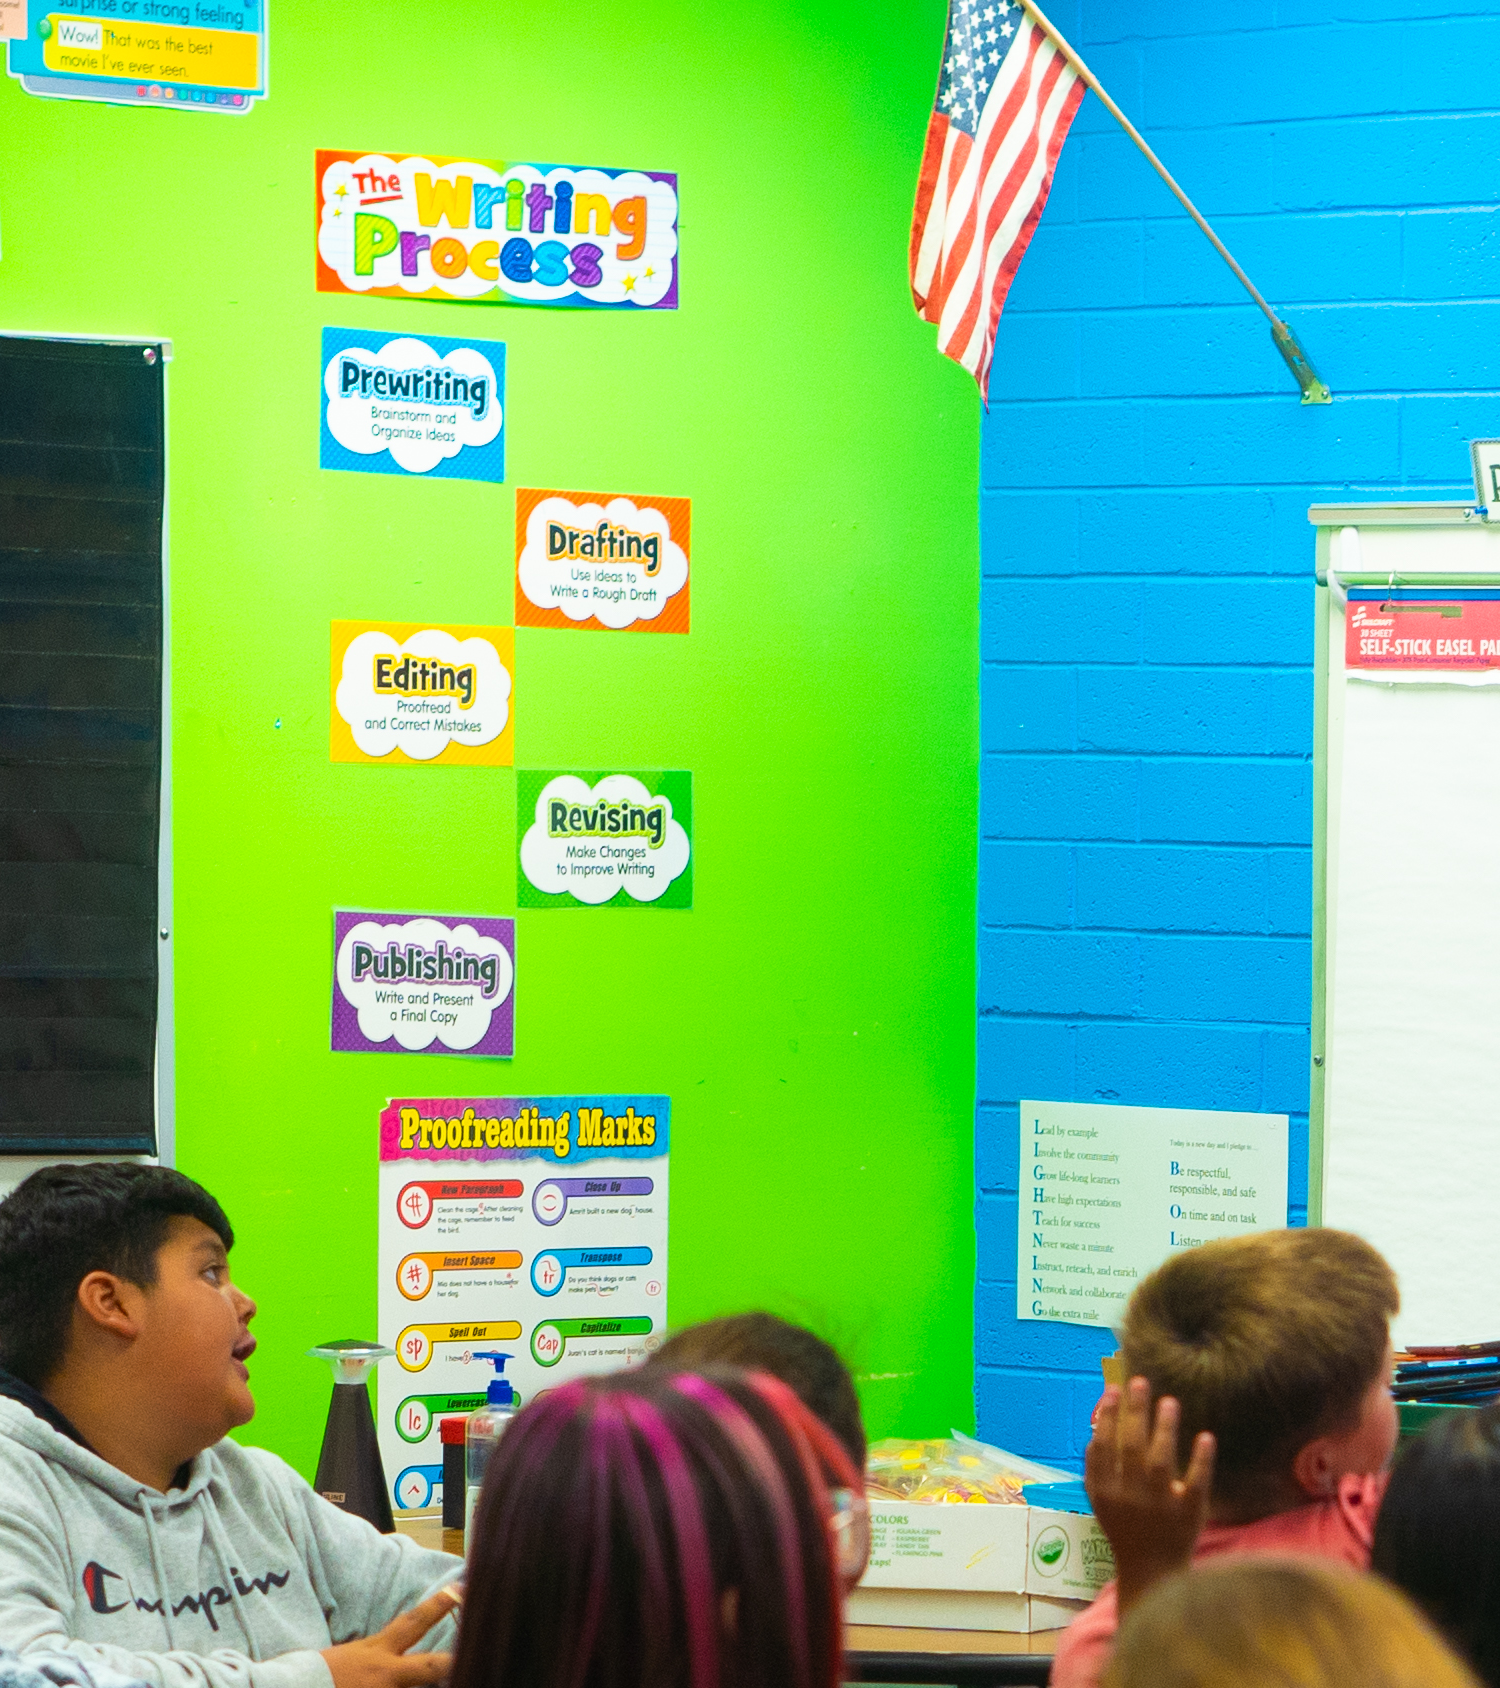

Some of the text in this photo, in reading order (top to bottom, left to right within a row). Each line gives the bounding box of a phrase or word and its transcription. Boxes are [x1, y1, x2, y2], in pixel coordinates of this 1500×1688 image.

[60, 25, 213, 55] Wow! That was the best
[353, 168, 647, 260] The Writing
[354, 212, 604, 287] Process
[341, 358, 488, 418] Prewriting
[371, 406, 456, 425] Brainstorm and
[548, 520, 660, 573] Drafting
[1360, 639, 1431, 655] SELF-STICK
[1436, 639, 1475, 655] EASEL
[376, 657, 473, 705] Editing
[397, 701, 451, 714] Proofread
[550, 799, 663, 845] Revising
[566, 846, 646, 862] Make Changes
[354, 944, 497, 995] Publishing
[390, 1009, 458, 1026] a Final Copy
[400, 1107, 656, 1157] Proofreading Marks
[1170, 1162, 1231, 1180] Be respectful,
[581, 1252, 622, 1263] Transpose
